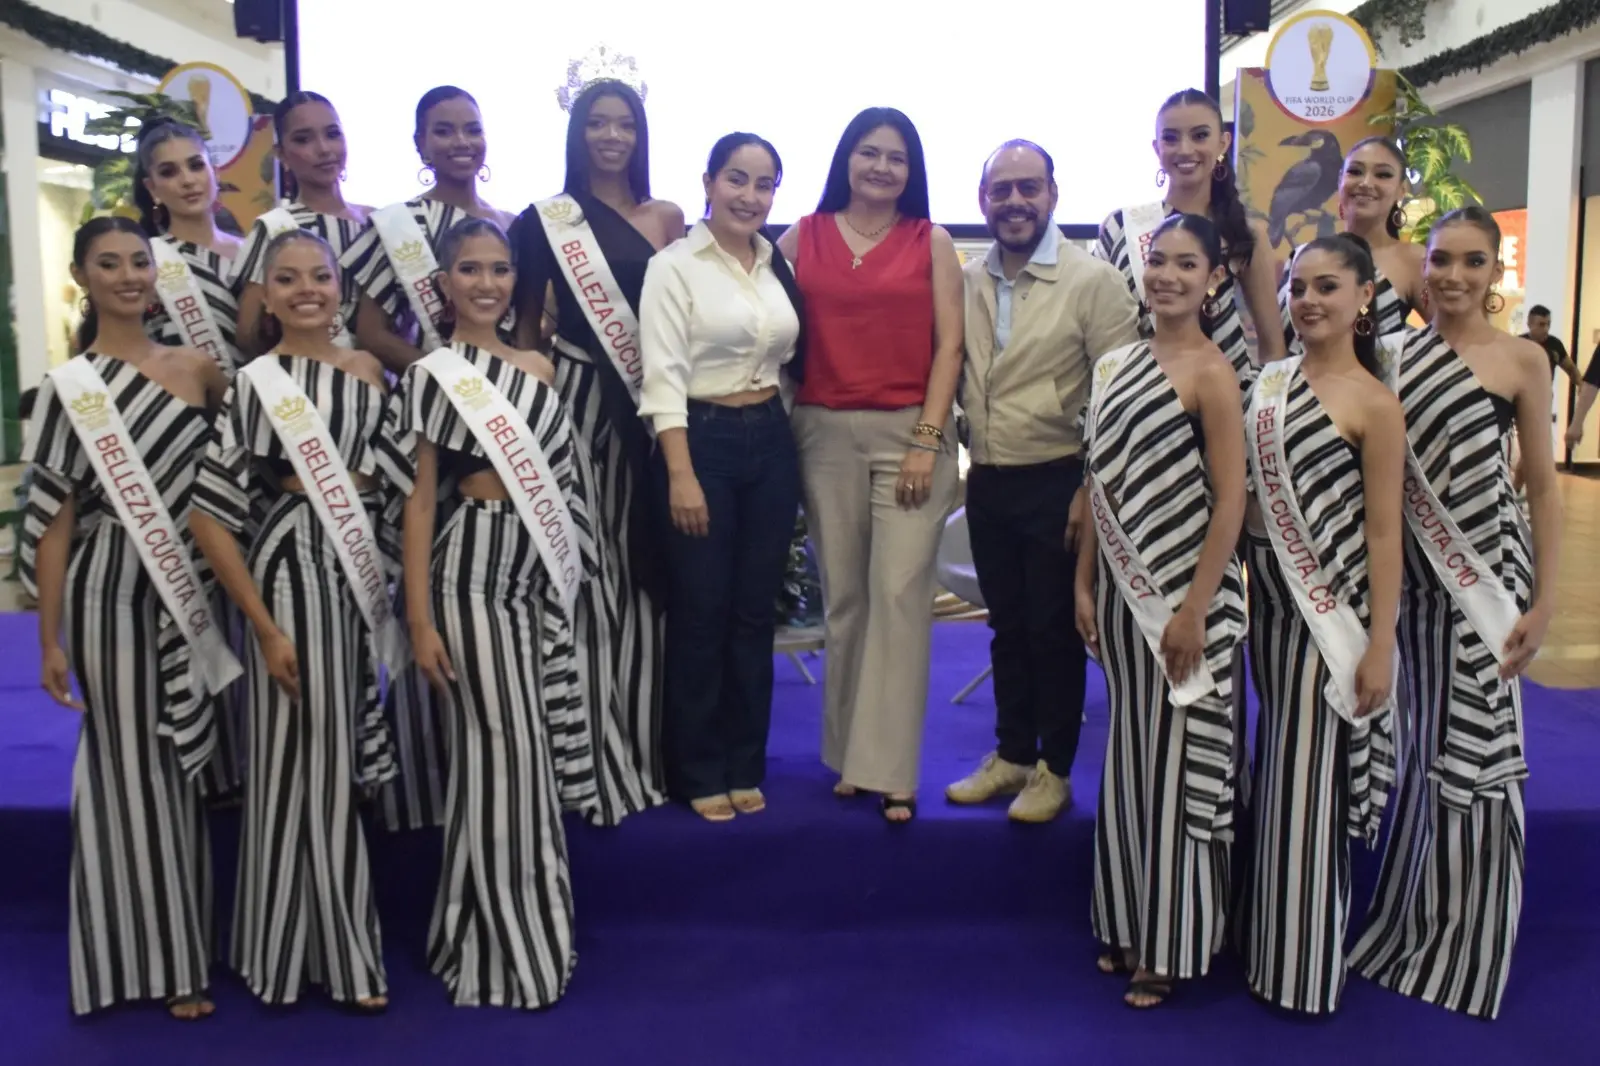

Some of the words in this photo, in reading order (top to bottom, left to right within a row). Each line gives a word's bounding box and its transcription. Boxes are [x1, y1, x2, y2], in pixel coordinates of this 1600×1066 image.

[1285, 96, 1302, 104] FIFA
[1304, 96, 1335, 104] WORLD
[1337, 96, 1354, 104] CUP
[1305, 105, 1335, 117] 2026
[413, 277, 443, 327] BELL
[561, 239, 614, 324] BELLEZA
[604, 321, 643, 388] CÚCU
[95, 433, 154, 529] BELLEZA
[297, 437, 355, 530] BELLEZA
[485, 414, 542, 502] BELLEZA
[1256, 406, 1281, 497] BELLEZA
[1308, 582, 1337, 615] C8
[1129, 573, 1155, 600] C7
[1446, 552, 1479, 588] C10
